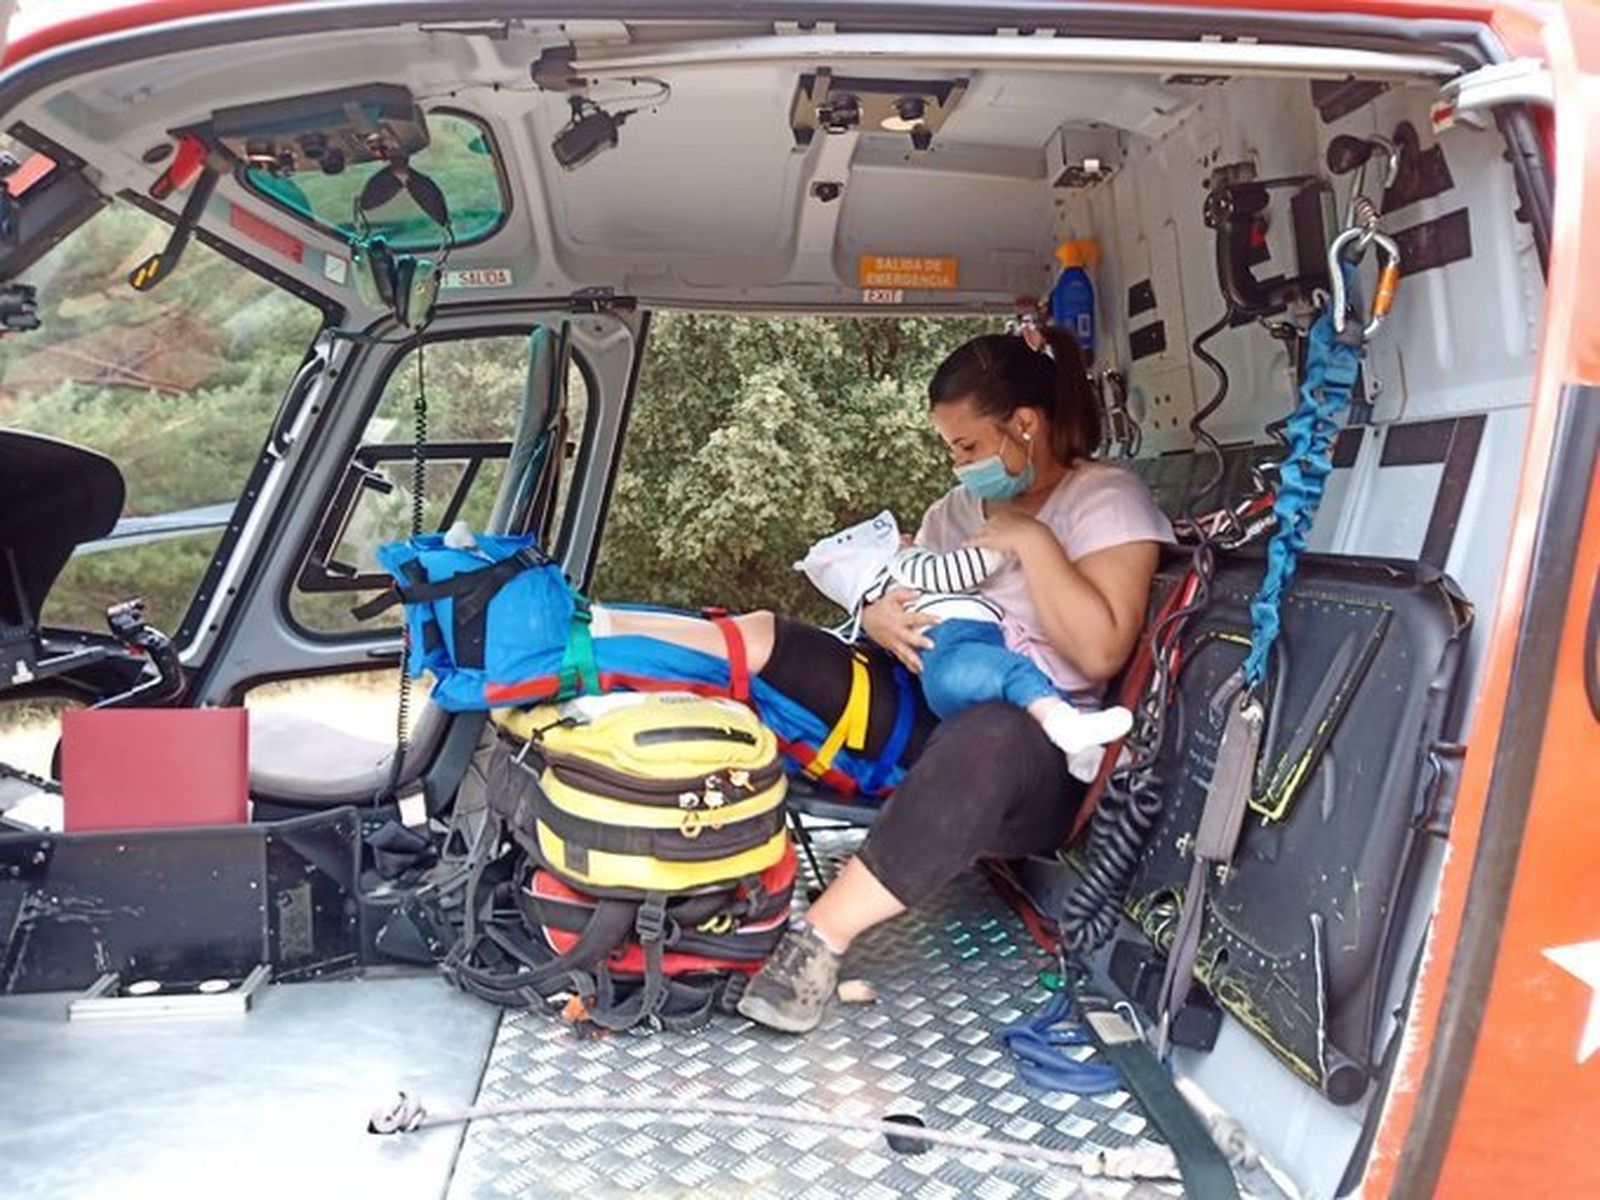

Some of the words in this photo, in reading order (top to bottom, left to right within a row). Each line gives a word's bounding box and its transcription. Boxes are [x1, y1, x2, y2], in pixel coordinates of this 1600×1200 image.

[875, 257, 922, 271] SALIDA
[925, 258, 942, 272] DE
[459, 270, 507, 285] SALIDA
[866, 272, 951, 287] EMERGENCIA
